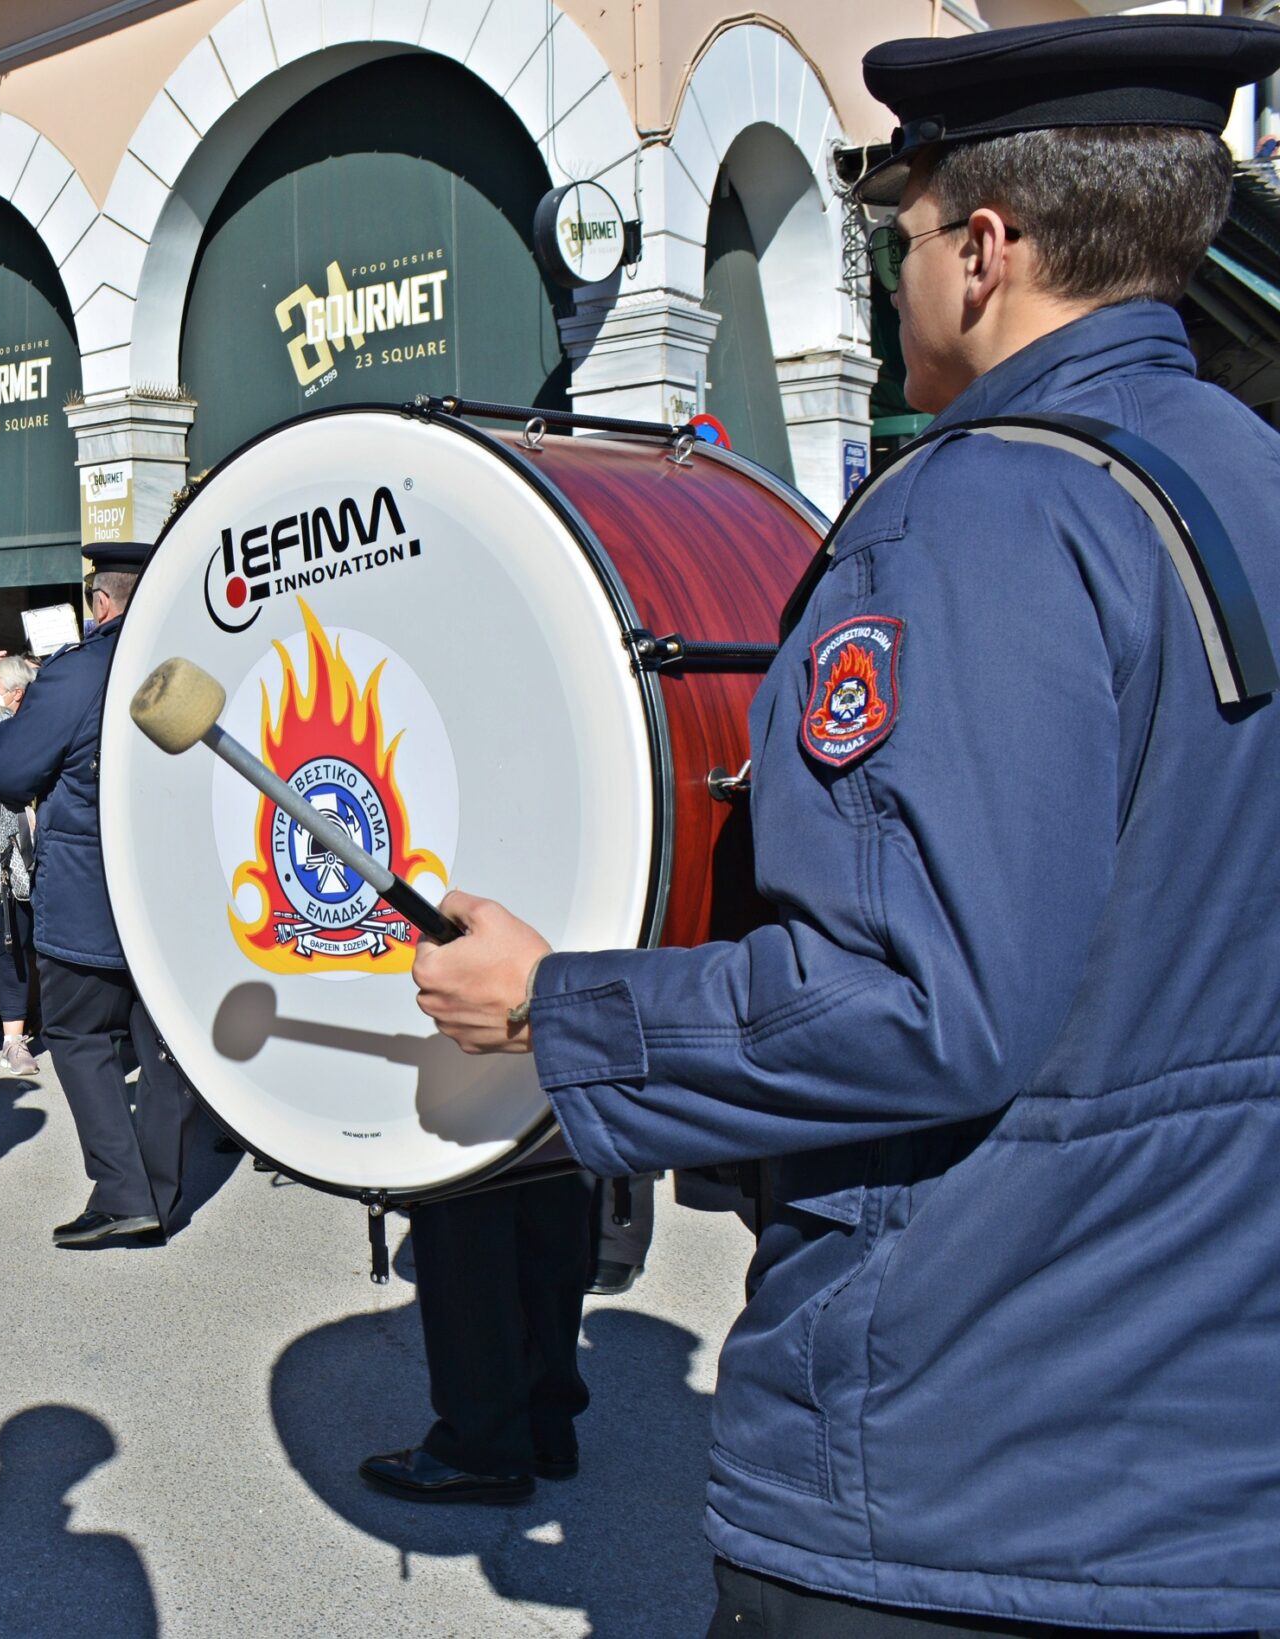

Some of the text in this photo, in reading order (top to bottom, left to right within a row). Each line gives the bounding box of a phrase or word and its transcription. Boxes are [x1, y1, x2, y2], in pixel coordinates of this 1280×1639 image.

[571, 220, 617, 241] GOURMET
[352, 249, 443, 277] FOOD DESIRE
[306, 269, 448, 345] GOURMET
[14, 339, 49, 352] DESIRE
[355, 339, 447, 369] 23 SQUARE
[304, 369, 338, 397] est. 1999
[5, 414, 49, 431] SQUARE
[94, 471, 123, 486] GOURMET
[88, 504, 126, 528] Happy
[95, 526, 120, 540] Hours
[275, 543, 404, 595] INNOVATION
[818, 627, 892, 665] ΠΥΡΟΣΒΕΣΤΙΚΟ ΣΩΜΑ
[822, 735, 866, 754] ΕΛΛΑΔΑΣ
[275, 764, 386, 852] ΠΥΡΒΕΣΤΙΚΟ ΣΩΜΑ
[306, 896, 368, 924] ΕΛΛΑΔΑΣ
[310, 938, 369, 952] ΘΑΡΣΕΙΝ ΣΩΖΕΙΝ
